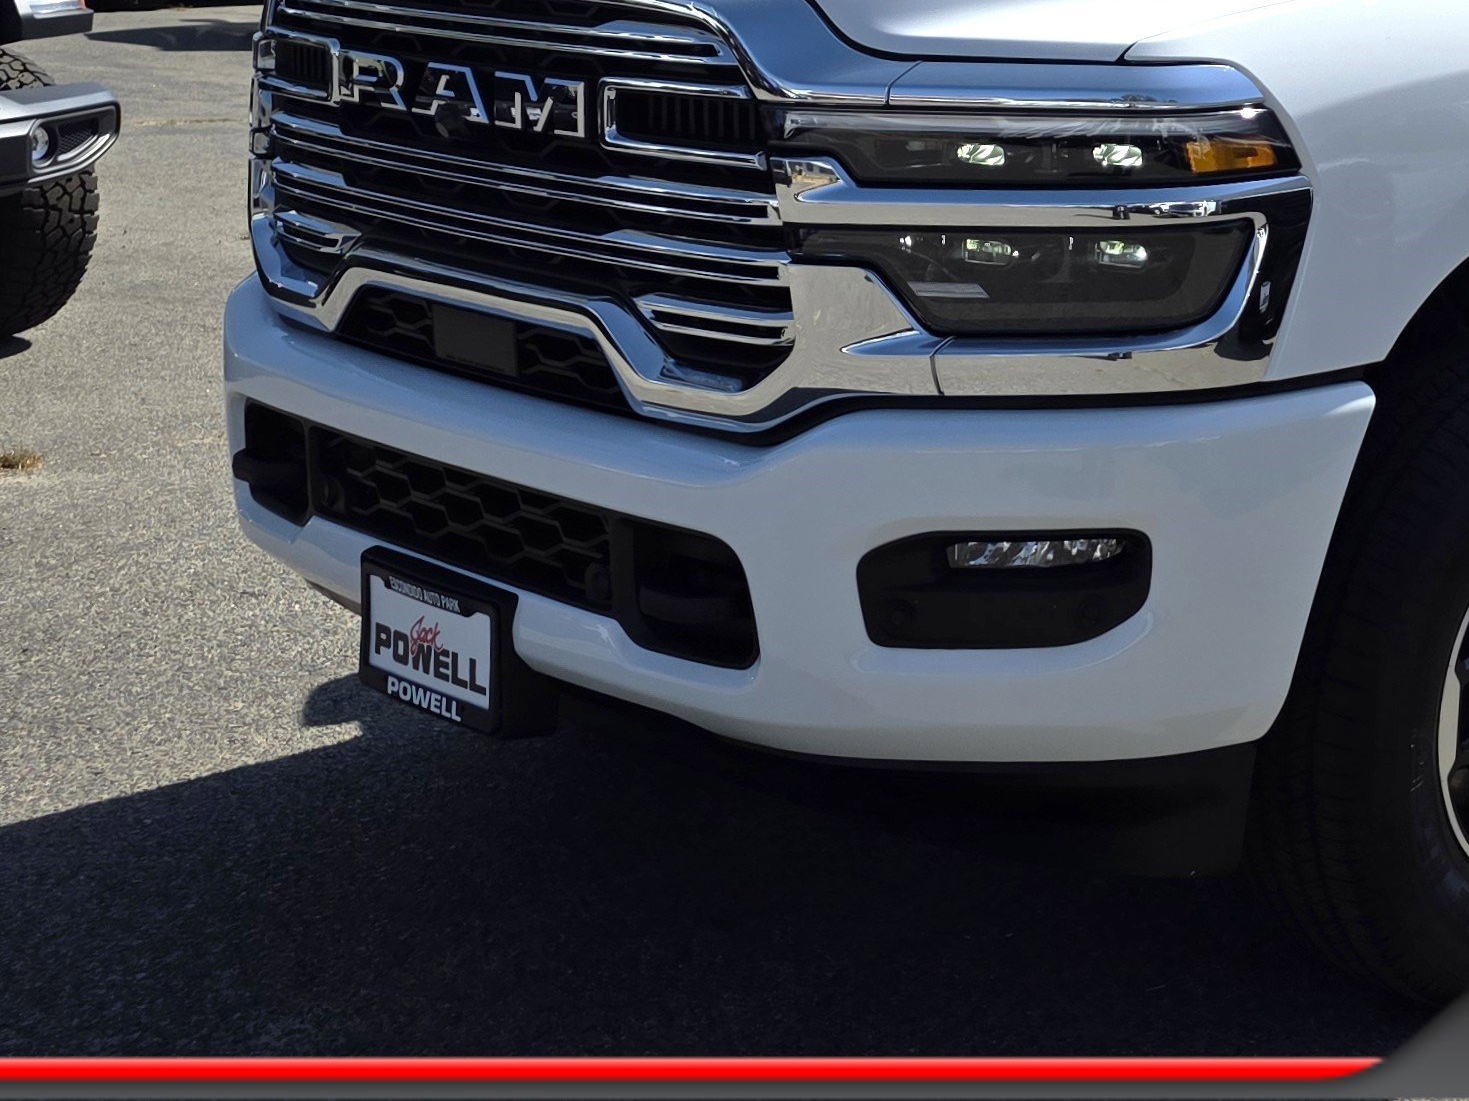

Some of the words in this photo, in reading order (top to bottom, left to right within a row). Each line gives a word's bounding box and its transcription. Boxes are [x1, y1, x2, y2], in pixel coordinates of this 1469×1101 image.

[338, 48, 587, 139] RAM
[375, 621, 487, 697] POWELL
[410, 615, 443, 657] Jack
[387, 675, 462, 722] POWELL
